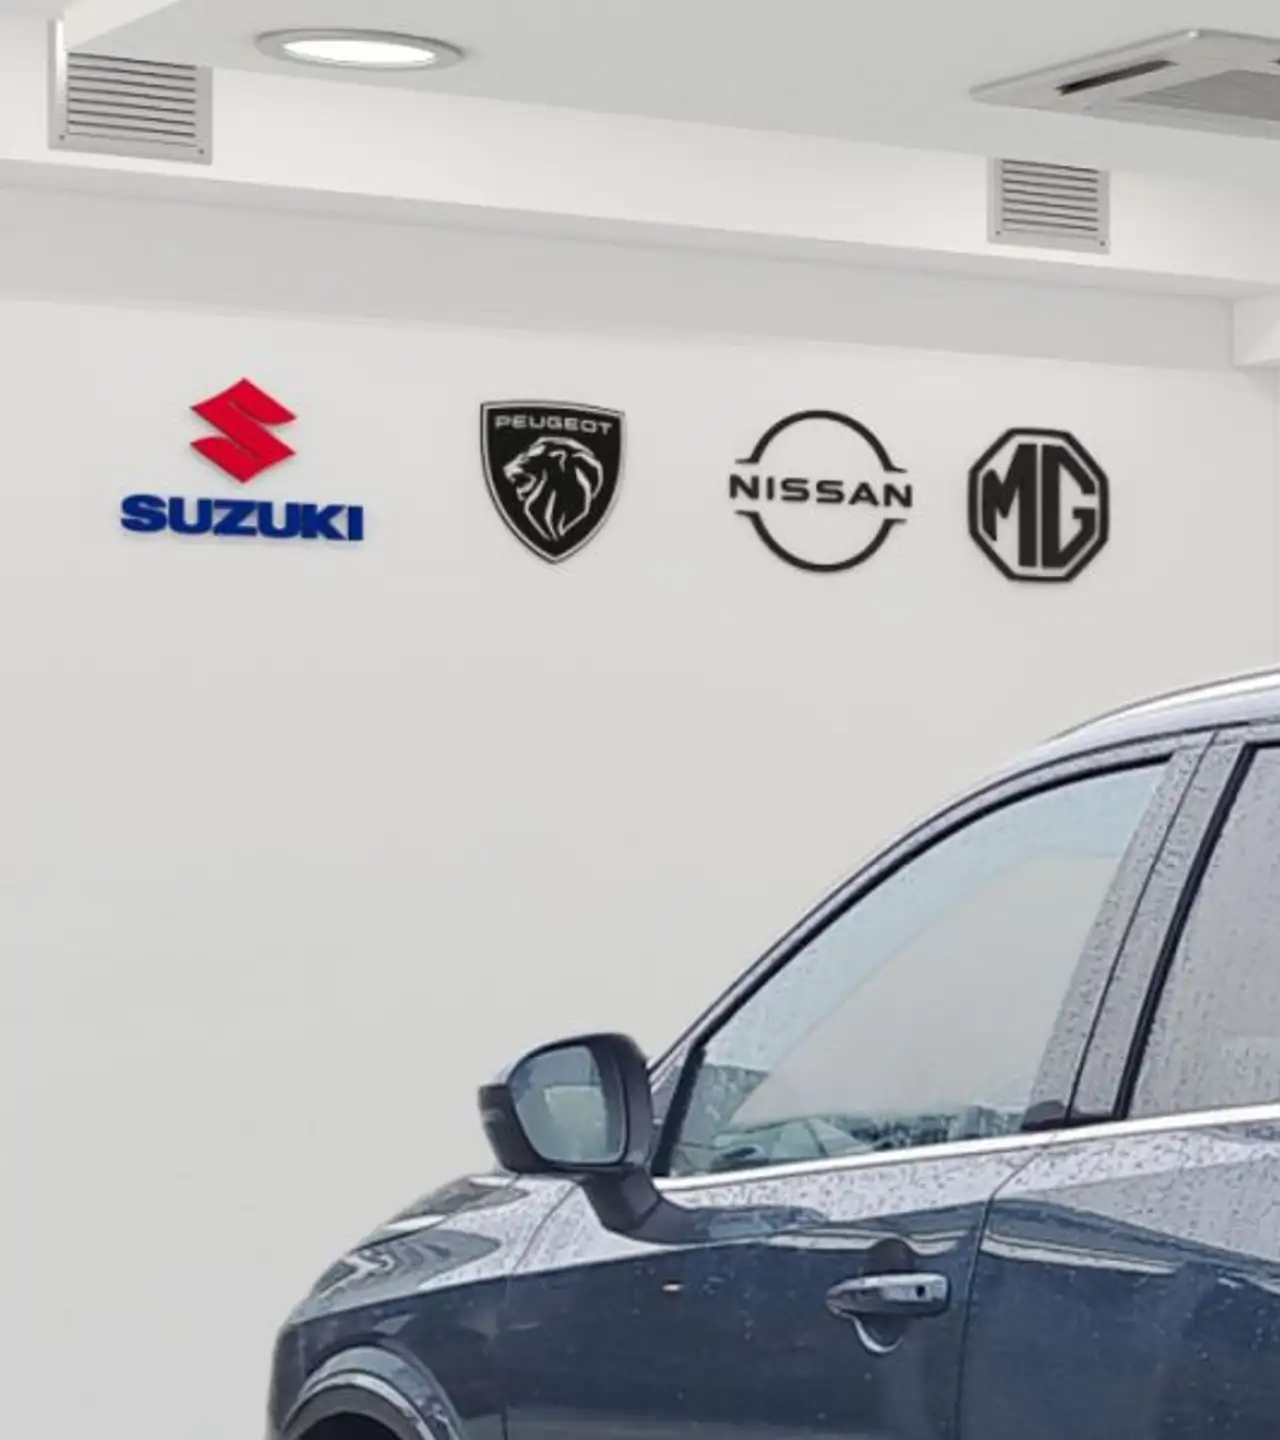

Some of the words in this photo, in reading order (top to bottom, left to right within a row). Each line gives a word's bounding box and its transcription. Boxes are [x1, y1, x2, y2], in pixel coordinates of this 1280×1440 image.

[494, 413, 612, 436] PEUGEOT
[729, 474, 914, 508] NISSAN
[984, 443, 1097, 570] MG
[120, 494, 364, 541] SUZUKI
